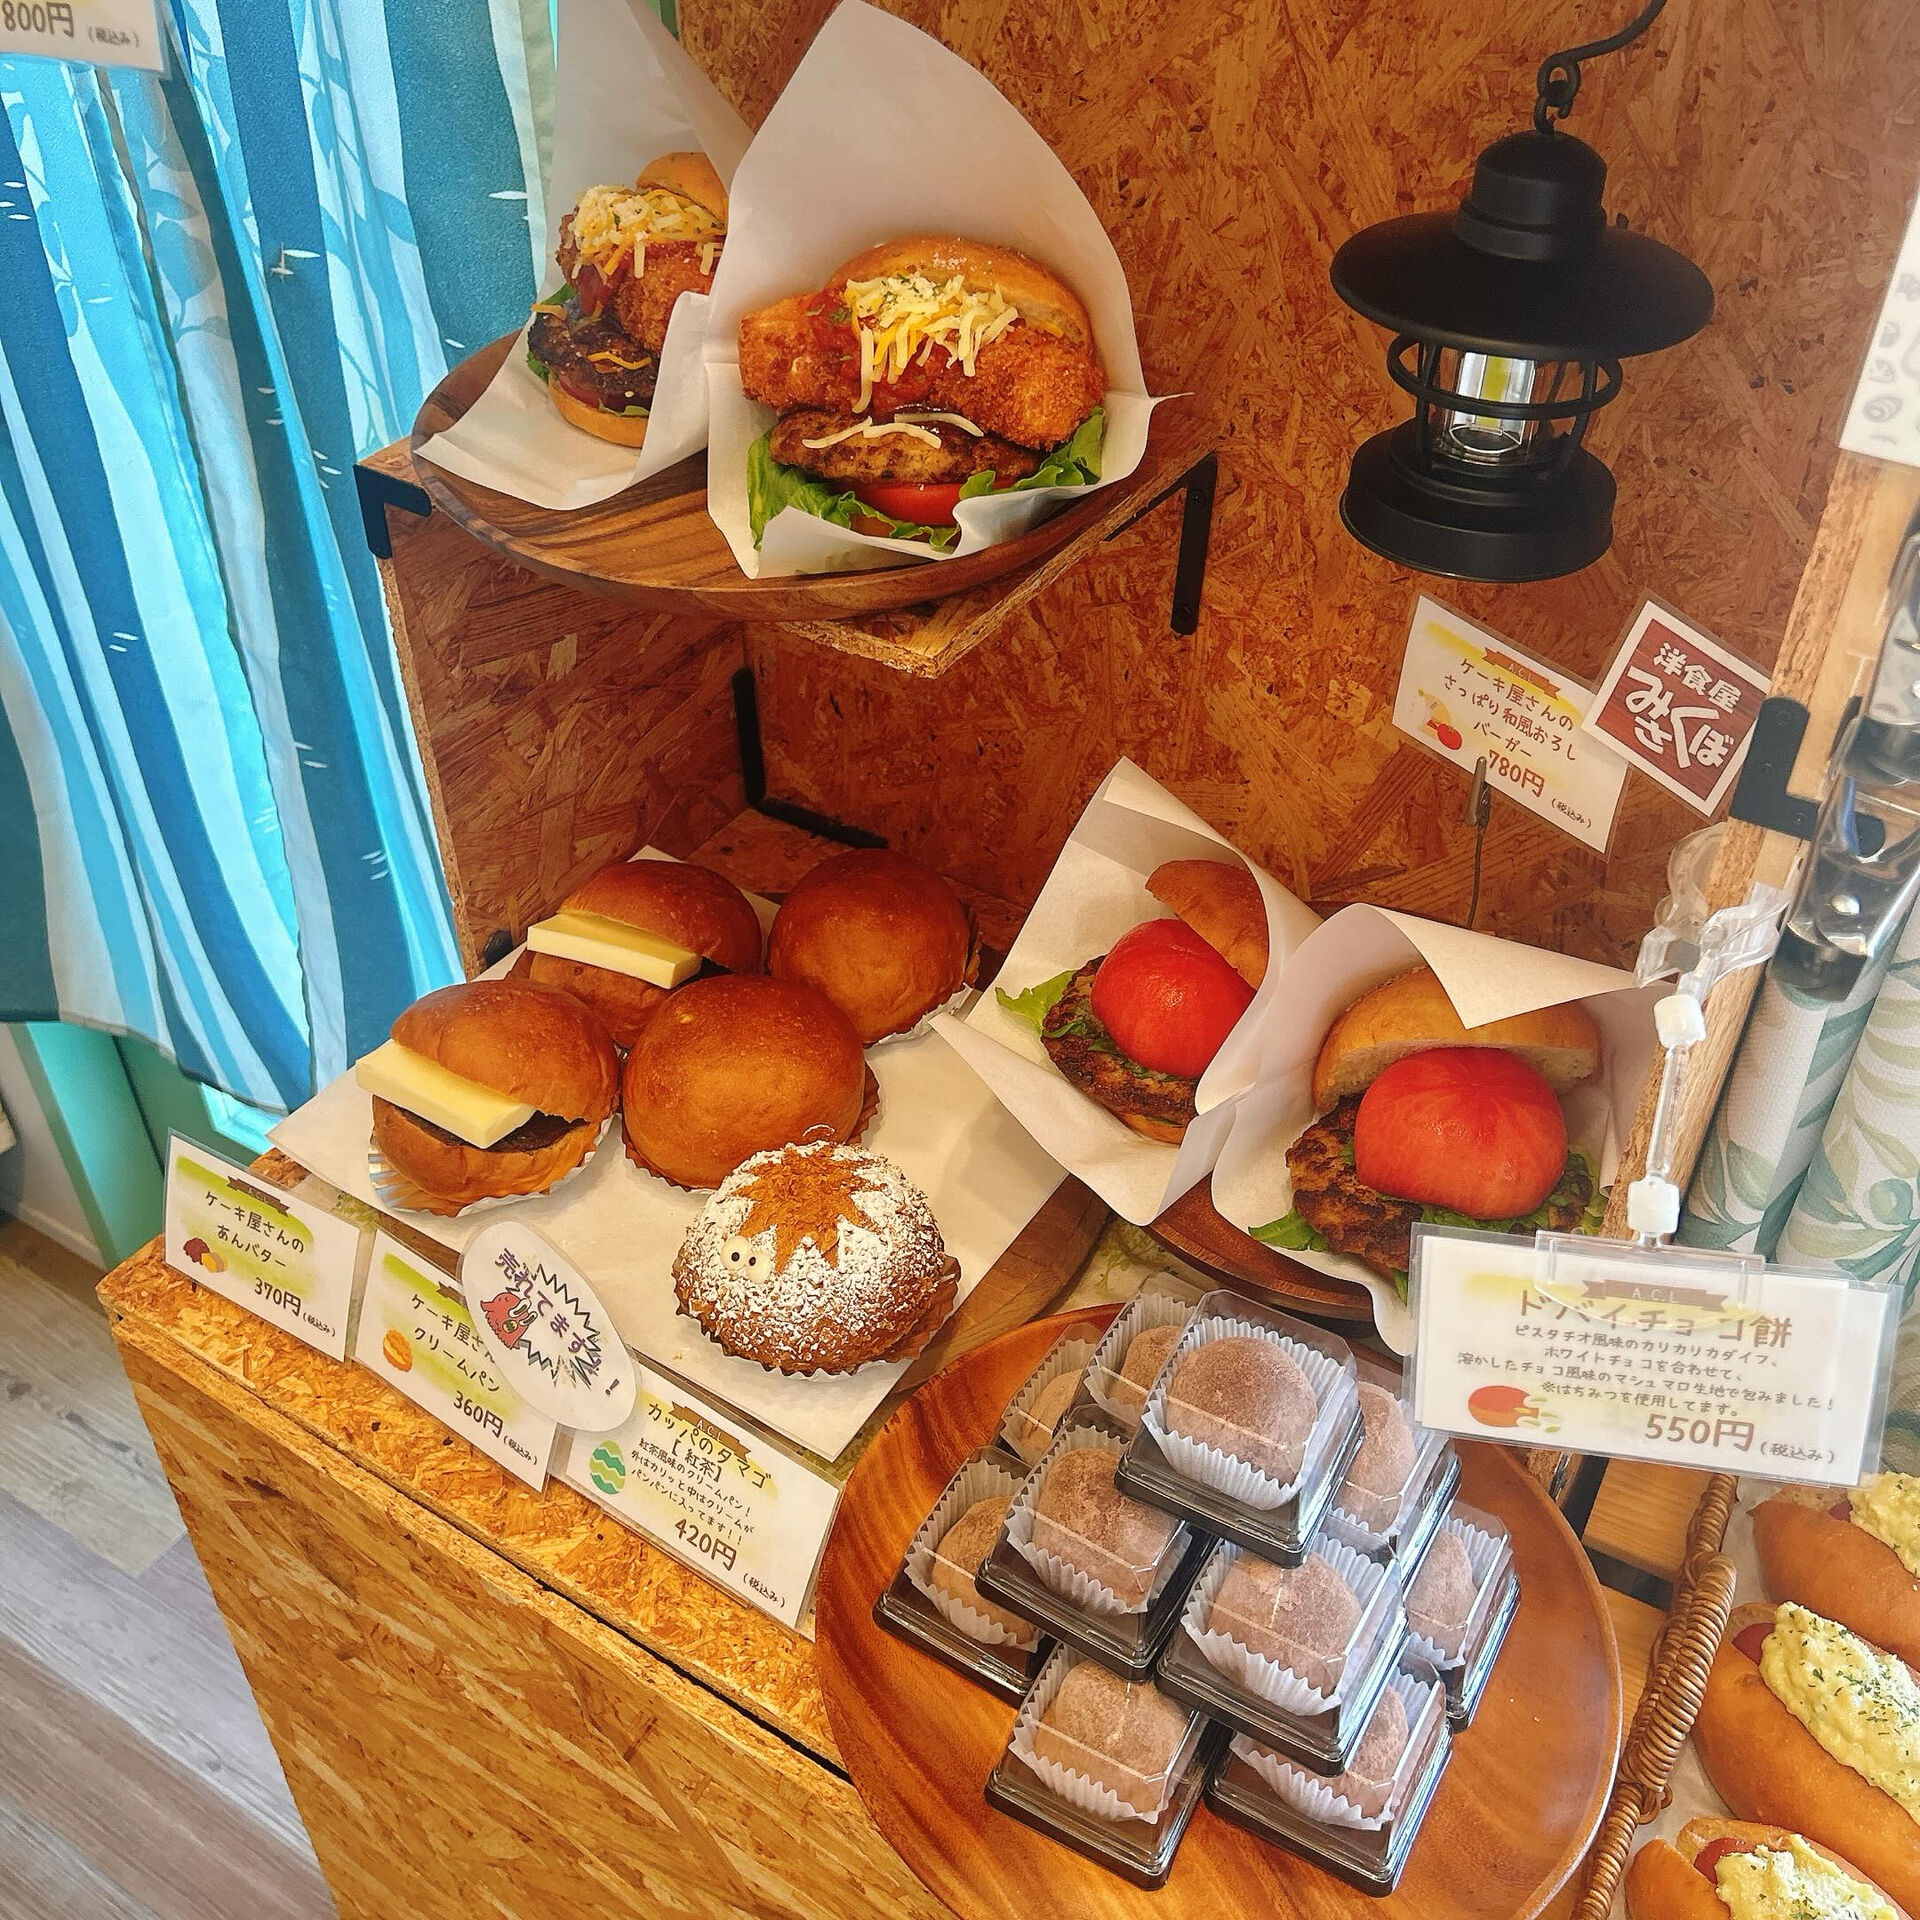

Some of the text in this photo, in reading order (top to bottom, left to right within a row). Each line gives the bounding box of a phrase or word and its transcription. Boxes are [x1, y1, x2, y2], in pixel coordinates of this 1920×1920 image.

[2, 0, 74, 37] 800円
[1460, 658, 1573, 731] ケーキ屋さんの
[1653, 642, 1742, 714] 洋食屋
[1444, 674, 1576, 761] さっぱり和風おろし
[1473, 721, 1532, 757] バーガー
[1488, 749, 1545, 798] 780円
[206, 1191, 305, 1253] ケーキ屋さんの
[217, 1224, 286, 1267] あんバター
[254, 1277, 302, 1316] 370円
[1521, 1289, 1792, 1348] ドバイチョコ餅
[414, 1327, 500, 1393] クリームパン
[1515, 1324, 1778, 1367] ピスタチオ風味のカリカリカダイフ、
[1544, 1346, 1742, 1381] ホワイトチョコを合わせて、
[453, 1390, 504, 1438] 360円
[1645, 1413, 1755, 1451] 550円
[648, 1403, 772, 1488] カッパのタマゴ
[671, 1439, 722, 1483] 【紅茶】
[631, 1450, 755, 1534] 外はカリッと中はクリームが
[639, 1437, 751, 1517] 紅茶風味のクリームパン！
[674, 1517, 737, 1571] 420円
